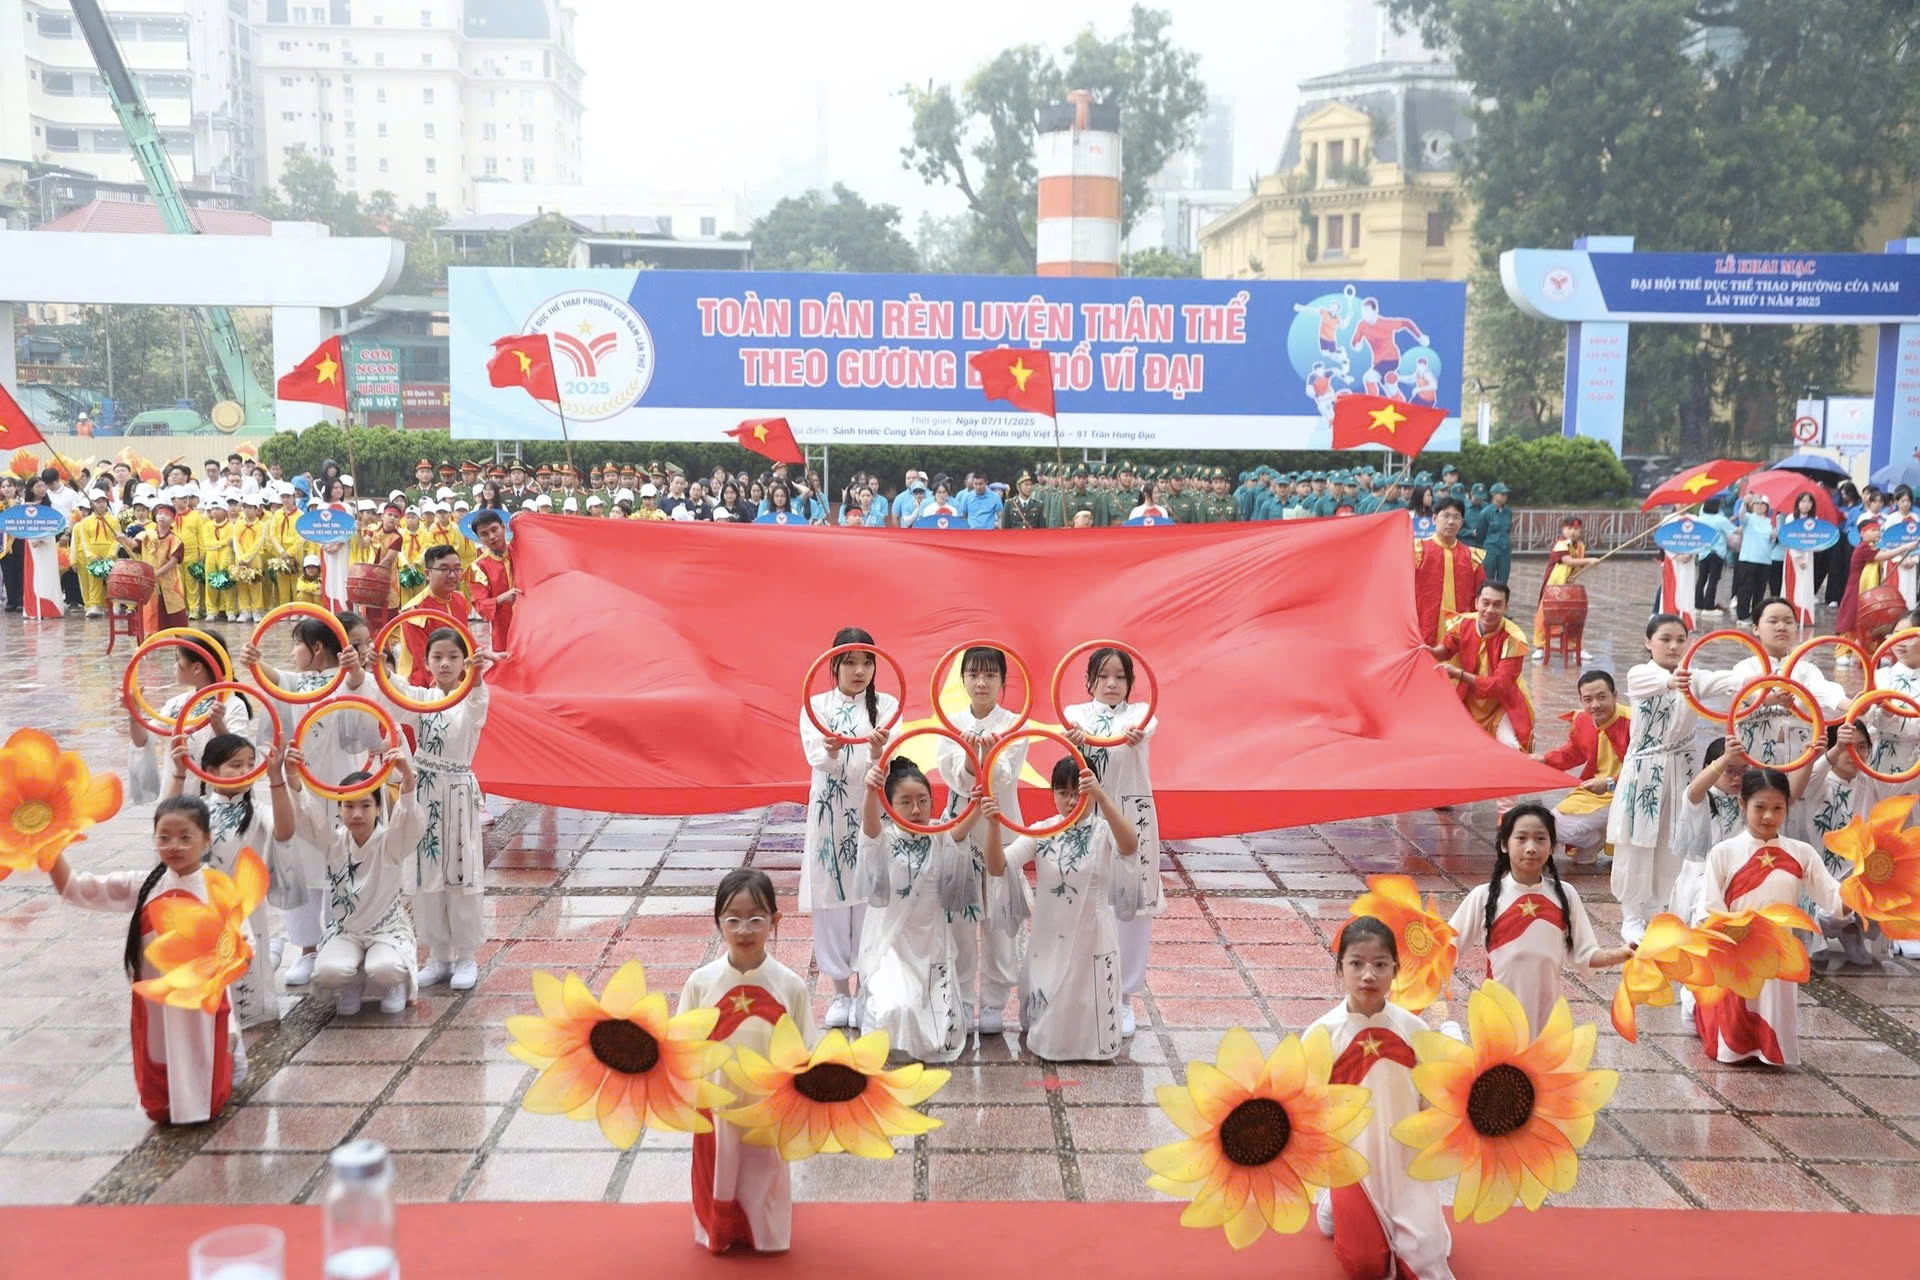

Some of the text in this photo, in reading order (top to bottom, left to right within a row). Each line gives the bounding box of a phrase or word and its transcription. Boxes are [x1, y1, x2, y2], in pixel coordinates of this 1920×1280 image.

[1714, 253, 1816, 279] LỄ KHAI MẠC
[1631, 276, 1900, 293] ĐẠI HỘI THỂ DỤC THỂ THAO PHƯỜNG CỬA NAM
[1706, 293, 1731, 306] LẦN
[1732, 294, 1759, 306] THỨ
[1766, 294, 1795, 307] NĂM
[1796, 295, 1821, 307] 2025
[562, 297, 581, 308] THAO
[582, 297, 614, 311] PHƯỜNG
[627, 319, 641, 337] NAM
[697, 290, 1250, 349] TOÀN DÂN RÈN LUYỆN THÂN THỂ
[355, 363, 399, 375] NGON
[740, 346, 827, 387] THEO
[836, 347, 956, 389] GƯƠNG
[1053, 341, 1092, 393] HỒ
[1102, 346, 1138, 392] VĨ
[1143, 353, 1203, 399] ĐẠI
[564, 381, 610, 395] 2025
[956, 416, 979, 426] Ngày
[982, 417, 1035, 426] 07/11/2025
[858, 428, 881, 436] trước
[883, 428, 906, 438] Cung
[909, 427, 926, 436] Văn
[947, 429, 964, 437] Lao
[966, 428, 988, 439] động
[991, 429, 1009, 438] Hữu
[1011, 429, 1031, 439] nghị
[1034, 430, 1051, 439] Việt
[1077, 431, 1087, 439] 91
[1091, 431, 1110, 439] Trần
[1112, 431, 1136, 441] Hưng
[1137, 431, 1156, 440] Đạo
